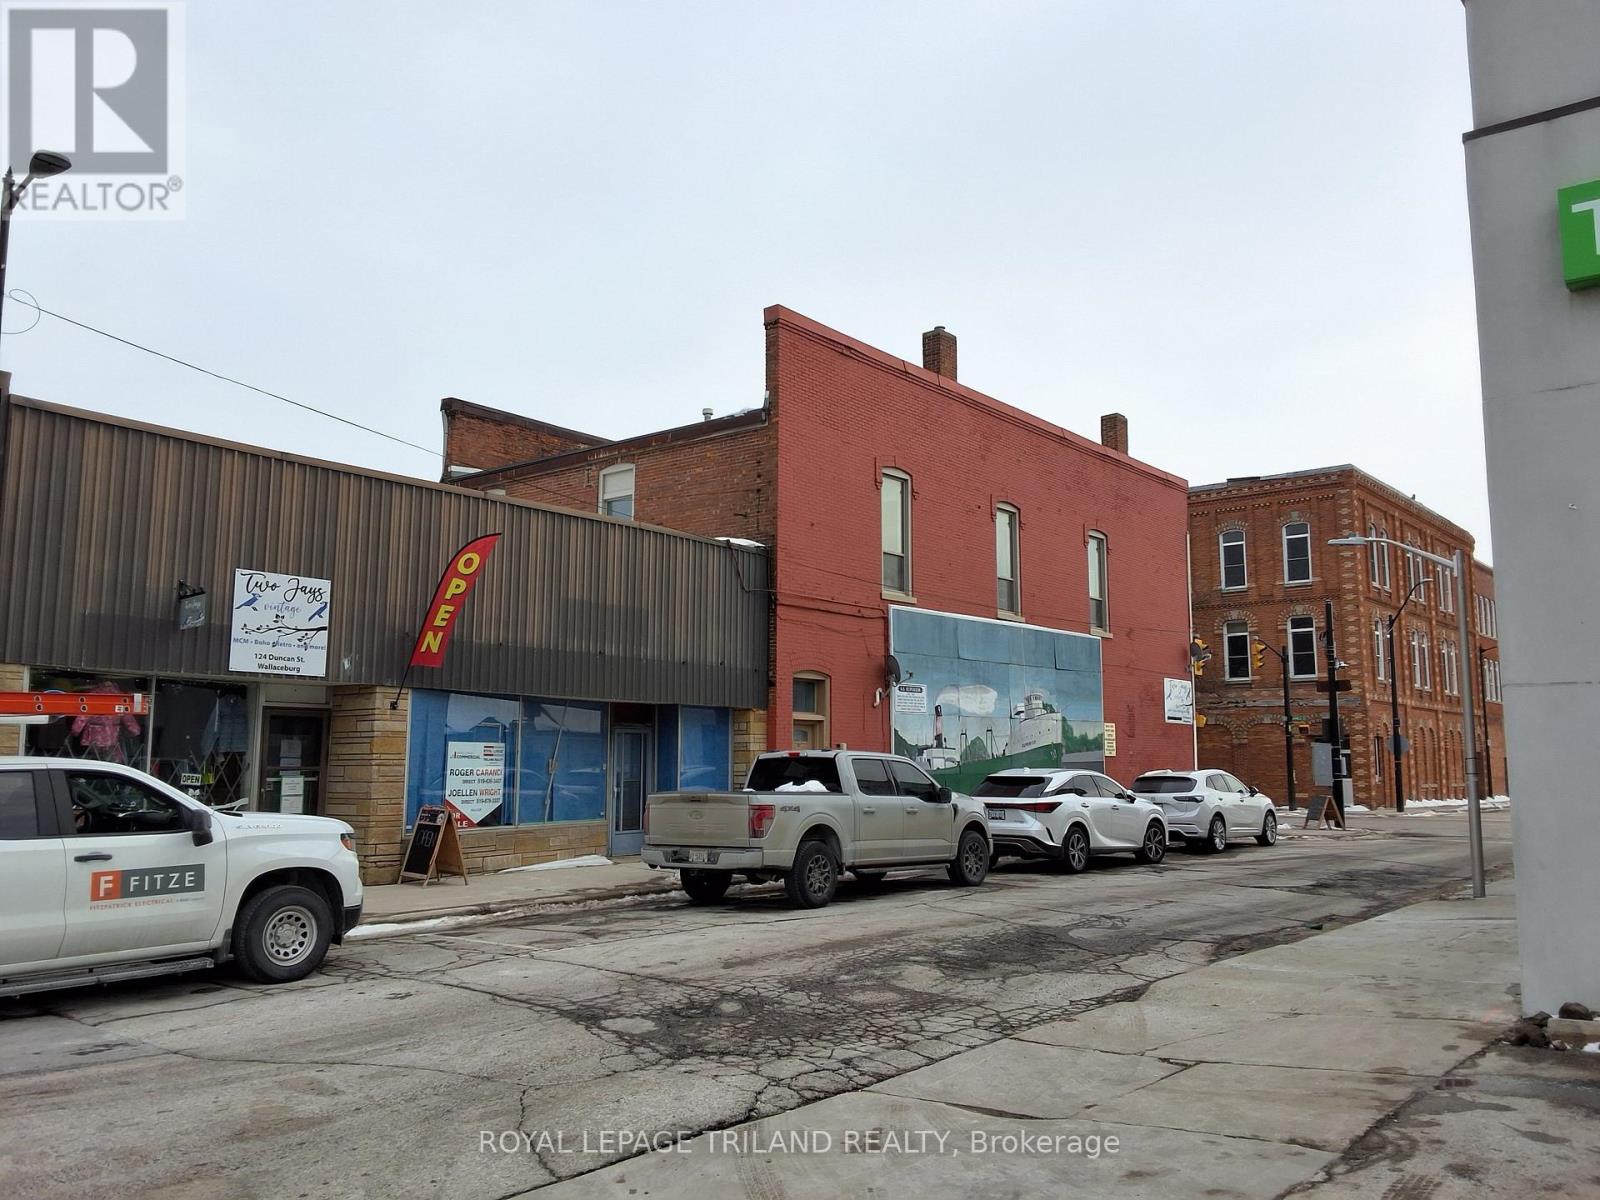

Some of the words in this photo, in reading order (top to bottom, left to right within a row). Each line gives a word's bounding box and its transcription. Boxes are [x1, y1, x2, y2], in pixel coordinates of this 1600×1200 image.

[240, 572, 280, 594] Two
[283, 577, 326, 604] Jays
[420, 552, 480, 653] OPEN
[264, 600, 302, 619] vintage
[268, 653, 295, 662] Duncan
[296, 655, 306, 663] St.
[257, 662, 301, 673] Wallaceburg
[450, 768, 475, 777] ROGER
[182, 774, 200, 784] OPEN
[448, 788, 478, 798] JOELLEN
[479, 788, 502, 797] WRIGHT
[100, 875, 113, 897] F
[129, 871, 196, 892] FITZE
